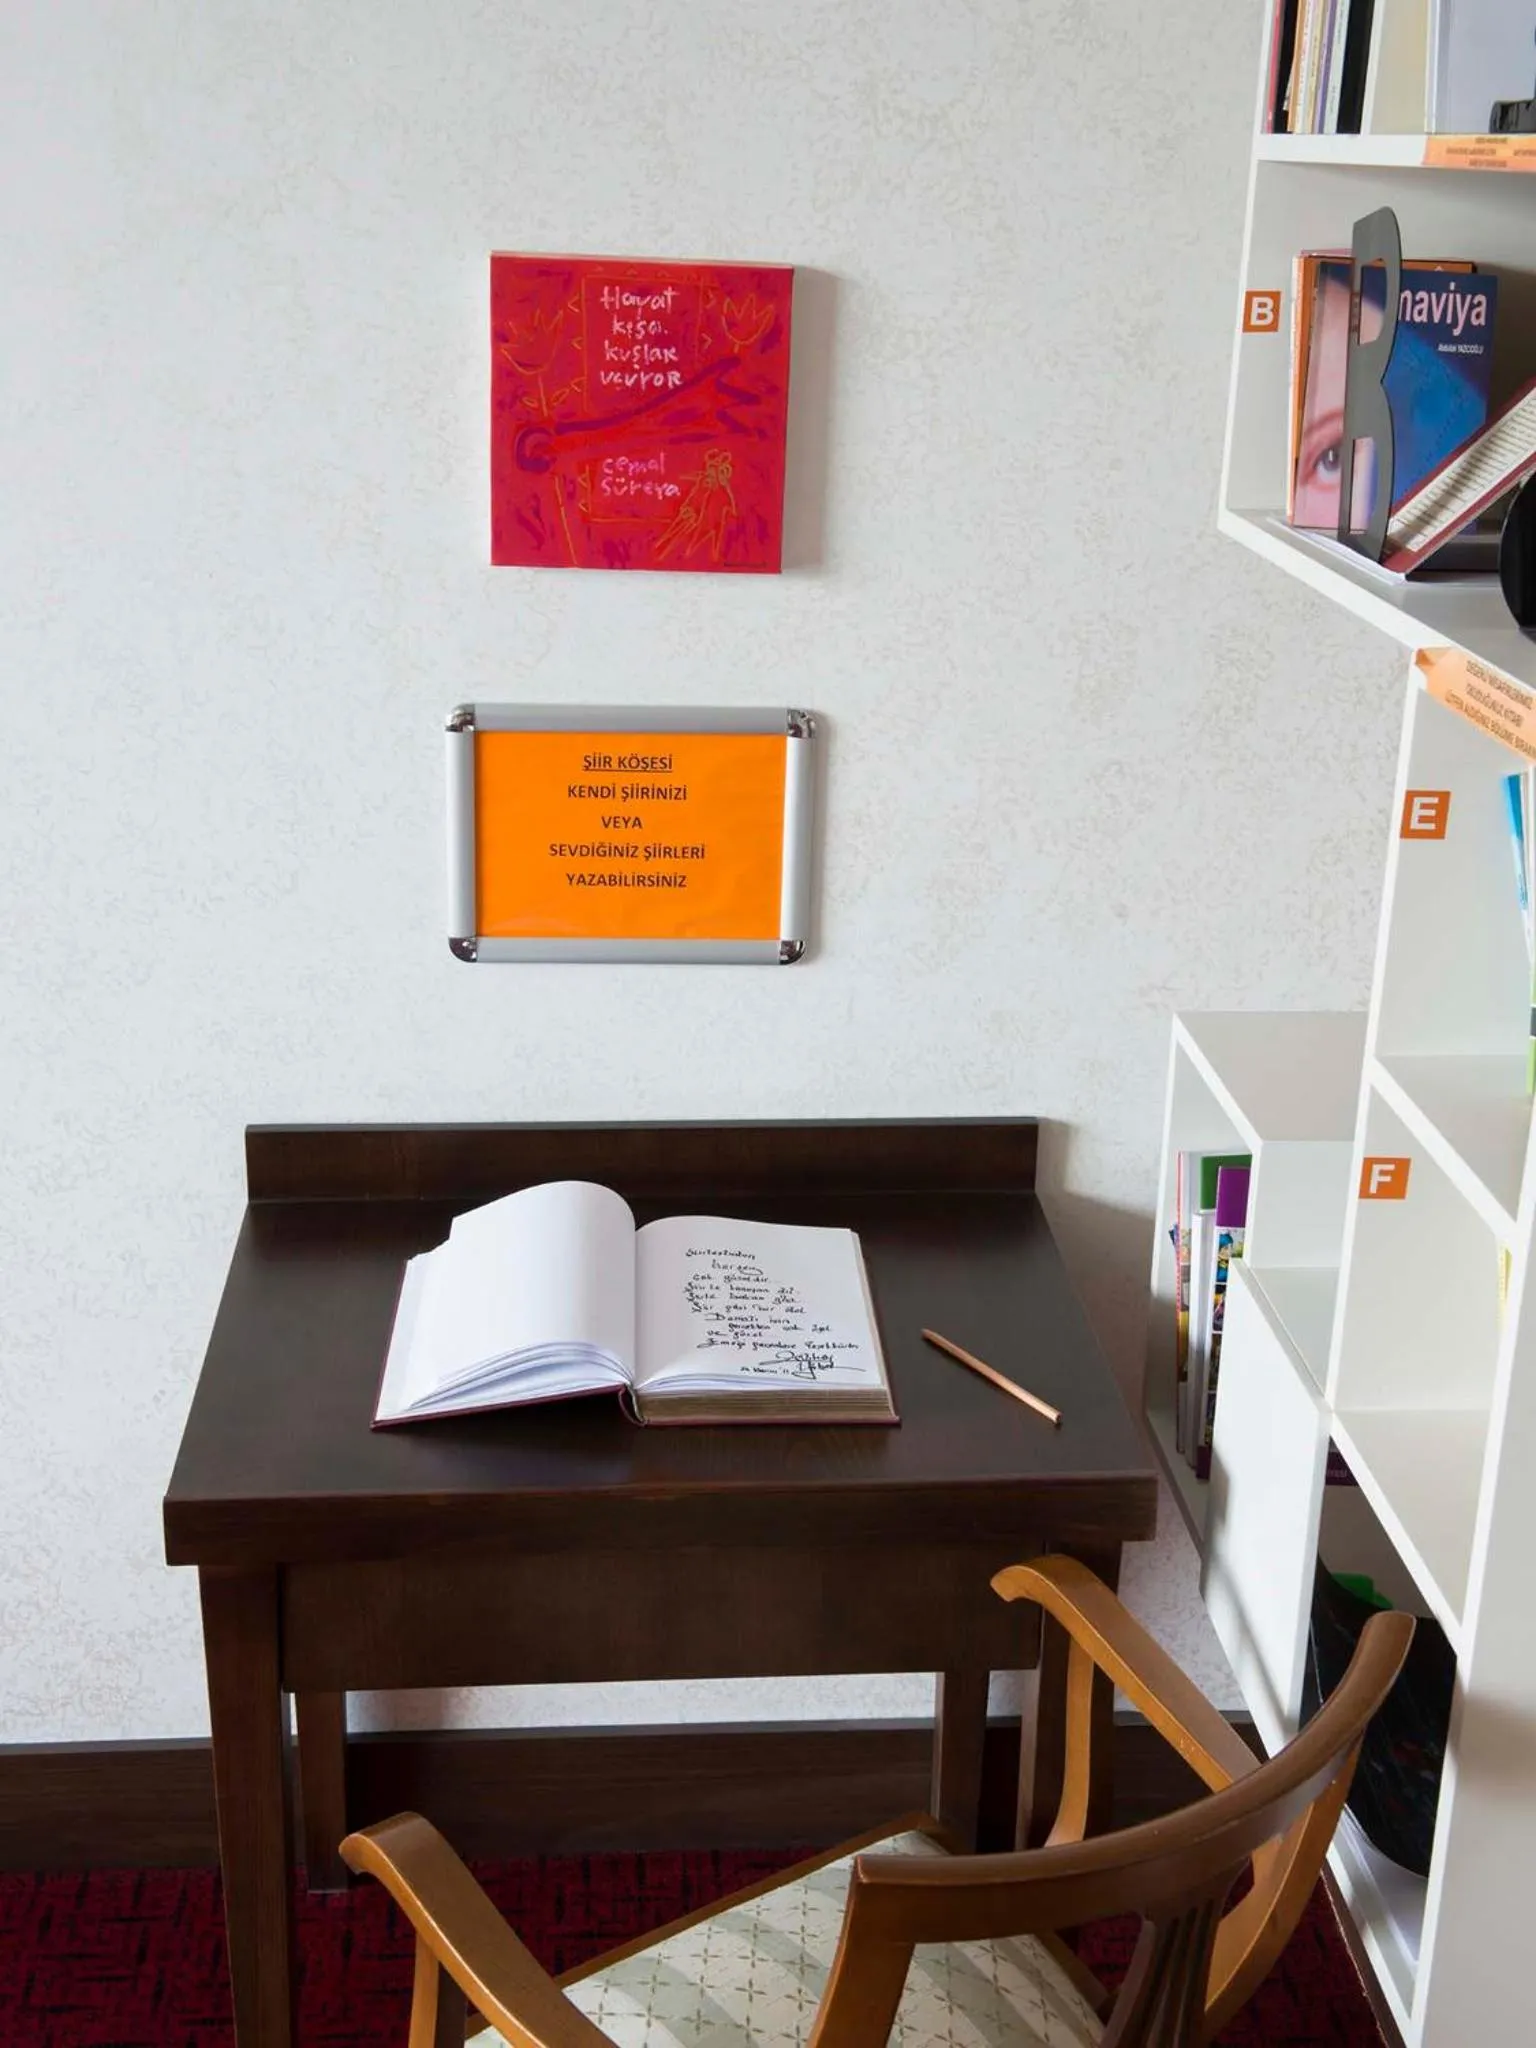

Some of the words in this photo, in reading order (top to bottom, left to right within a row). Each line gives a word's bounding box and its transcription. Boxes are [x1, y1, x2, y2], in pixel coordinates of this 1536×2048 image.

[600, 285, 680, 319] Hayat
[1250, 296, 1275, 327] B
[618, 753, 673, 772] KÖŞESİ
[568, 783, 616, 799] KENDİ
[621, 784, 687, 802] ŞİİRİNİZİ
[601, 816, 643, 829] VEYA
[1408, 796, 1439, 831] E
[549, 842, 639, 858] SEVDİĞİNİZ
[643, 843, 705, 861] ŞİİRLERİ
[1368, 1163, 1395, 1194] F
